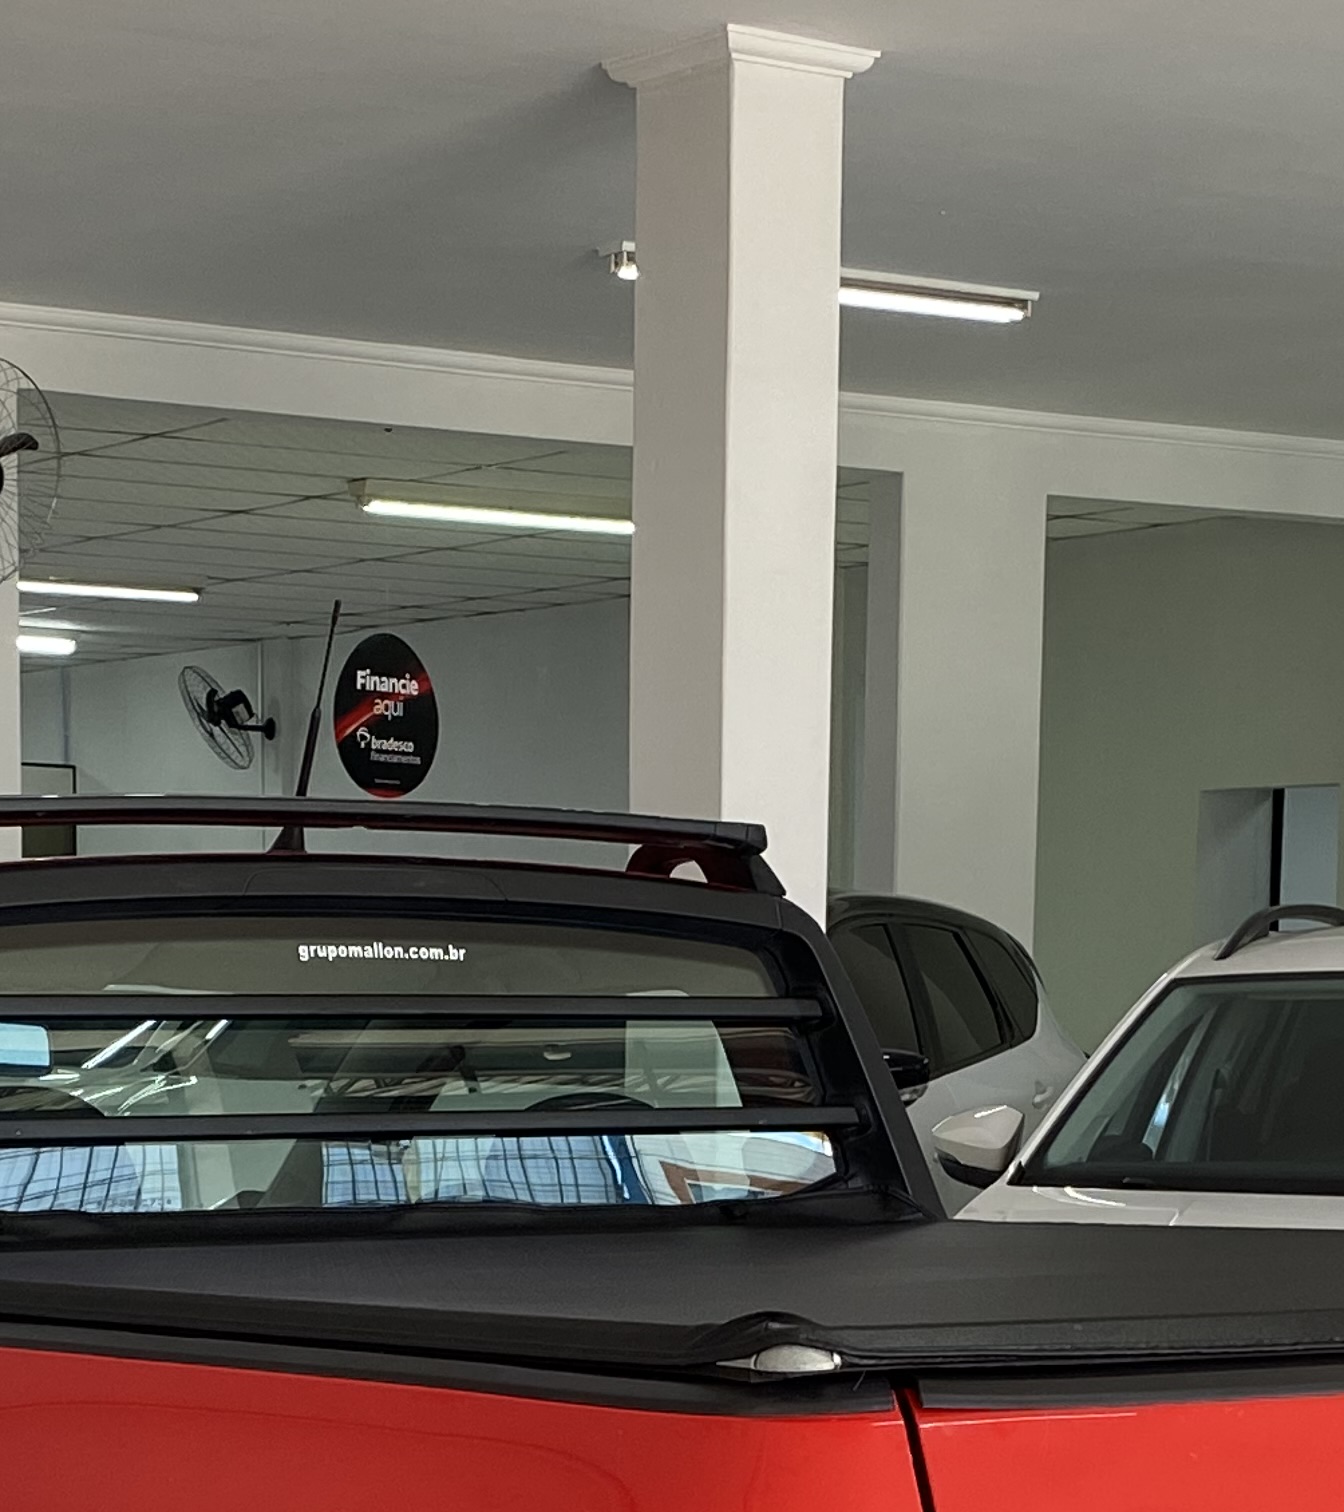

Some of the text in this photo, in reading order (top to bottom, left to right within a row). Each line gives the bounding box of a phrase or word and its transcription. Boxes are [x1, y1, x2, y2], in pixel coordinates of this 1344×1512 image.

[356, 669, 419, 695] Financie
[372, 698, 404, 721] aqui
[370, 735, 415, 753] bradesco
[297, 941, 467, 962] grupomallon.com.br
